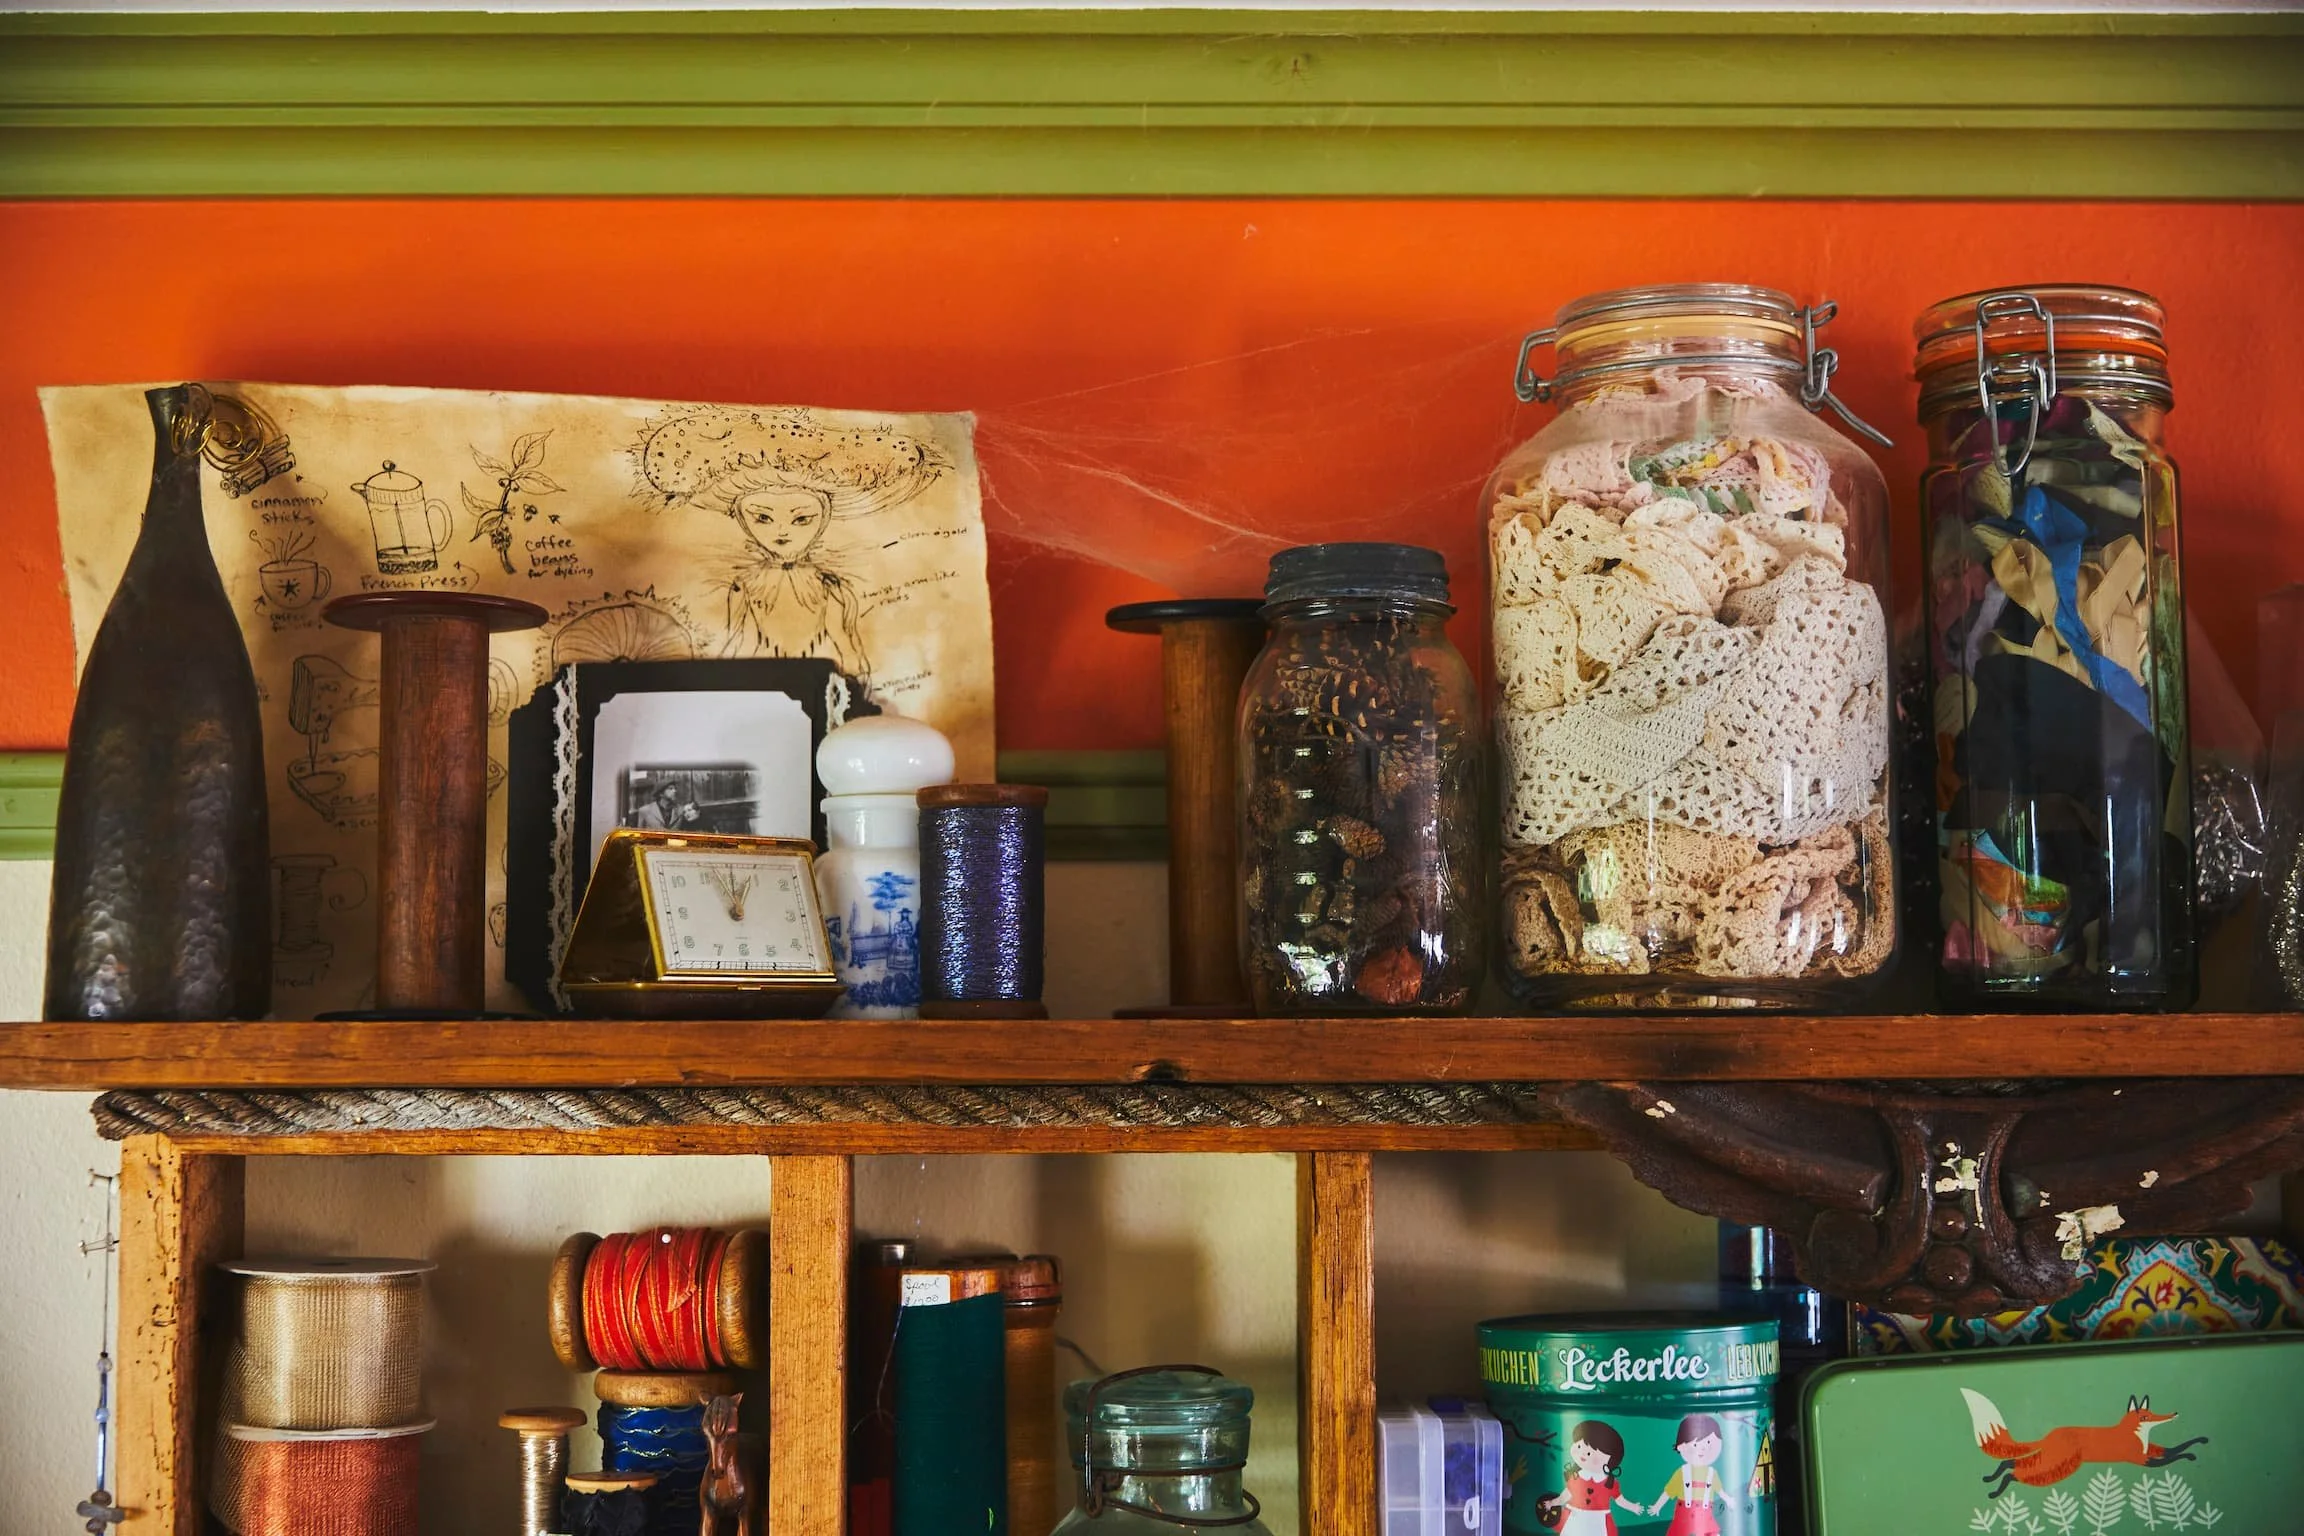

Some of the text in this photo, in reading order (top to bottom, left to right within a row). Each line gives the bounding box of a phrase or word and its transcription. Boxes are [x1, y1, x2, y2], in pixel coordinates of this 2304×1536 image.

[531, 553, 578, 567] beans
[1480, 1347, 1539, 1385] BKUCHEN
[1558, 1344, 1710, 1391] Leckerlee
